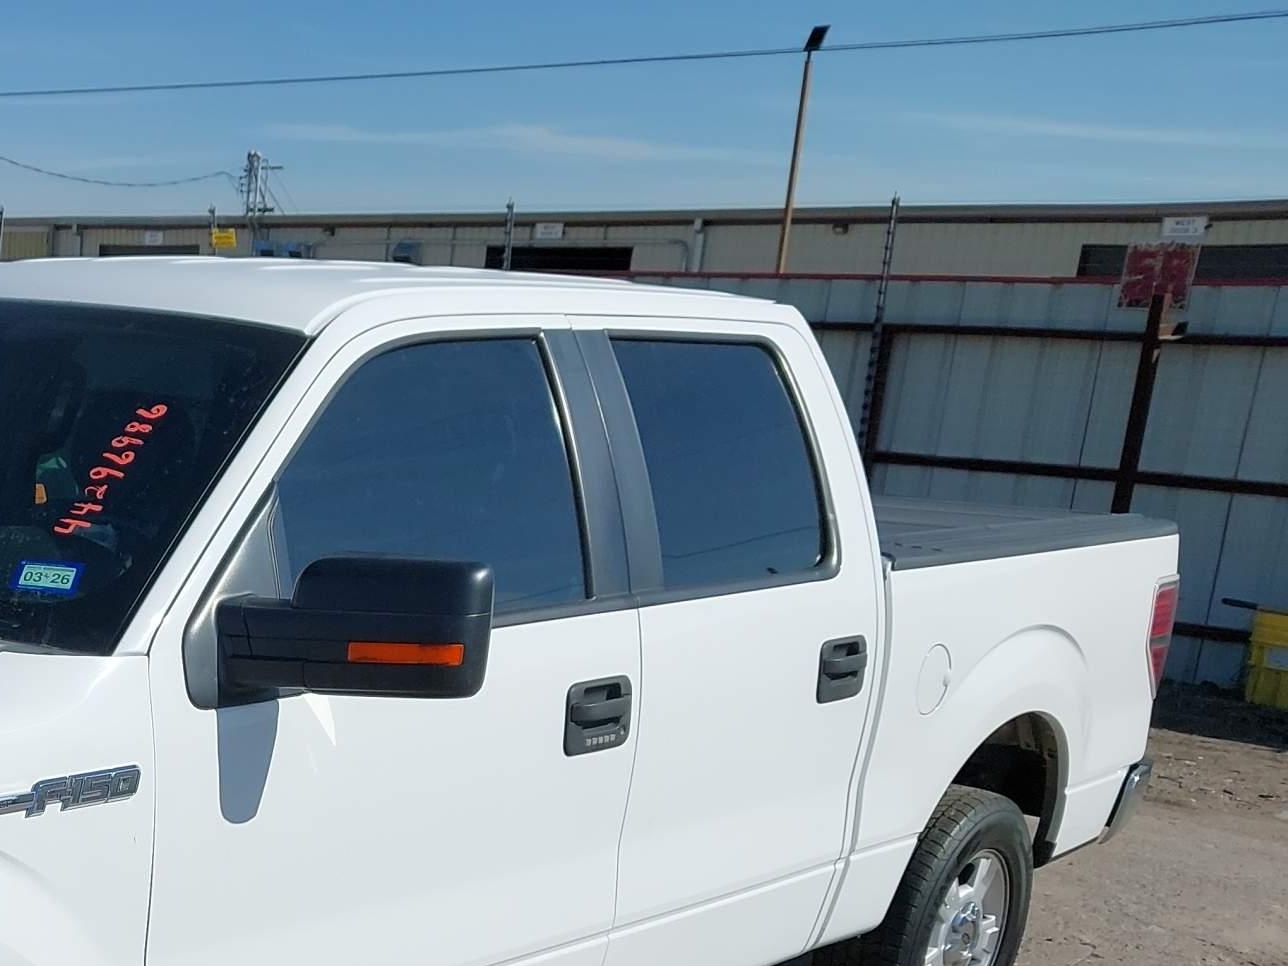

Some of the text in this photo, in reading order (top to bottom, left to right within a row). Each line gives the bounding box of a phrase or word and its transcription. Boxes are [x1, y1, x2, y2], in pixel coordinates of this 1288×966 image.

[53, 404, 169, 534] 44296986
[23, 571, 72, 585] 03 26
